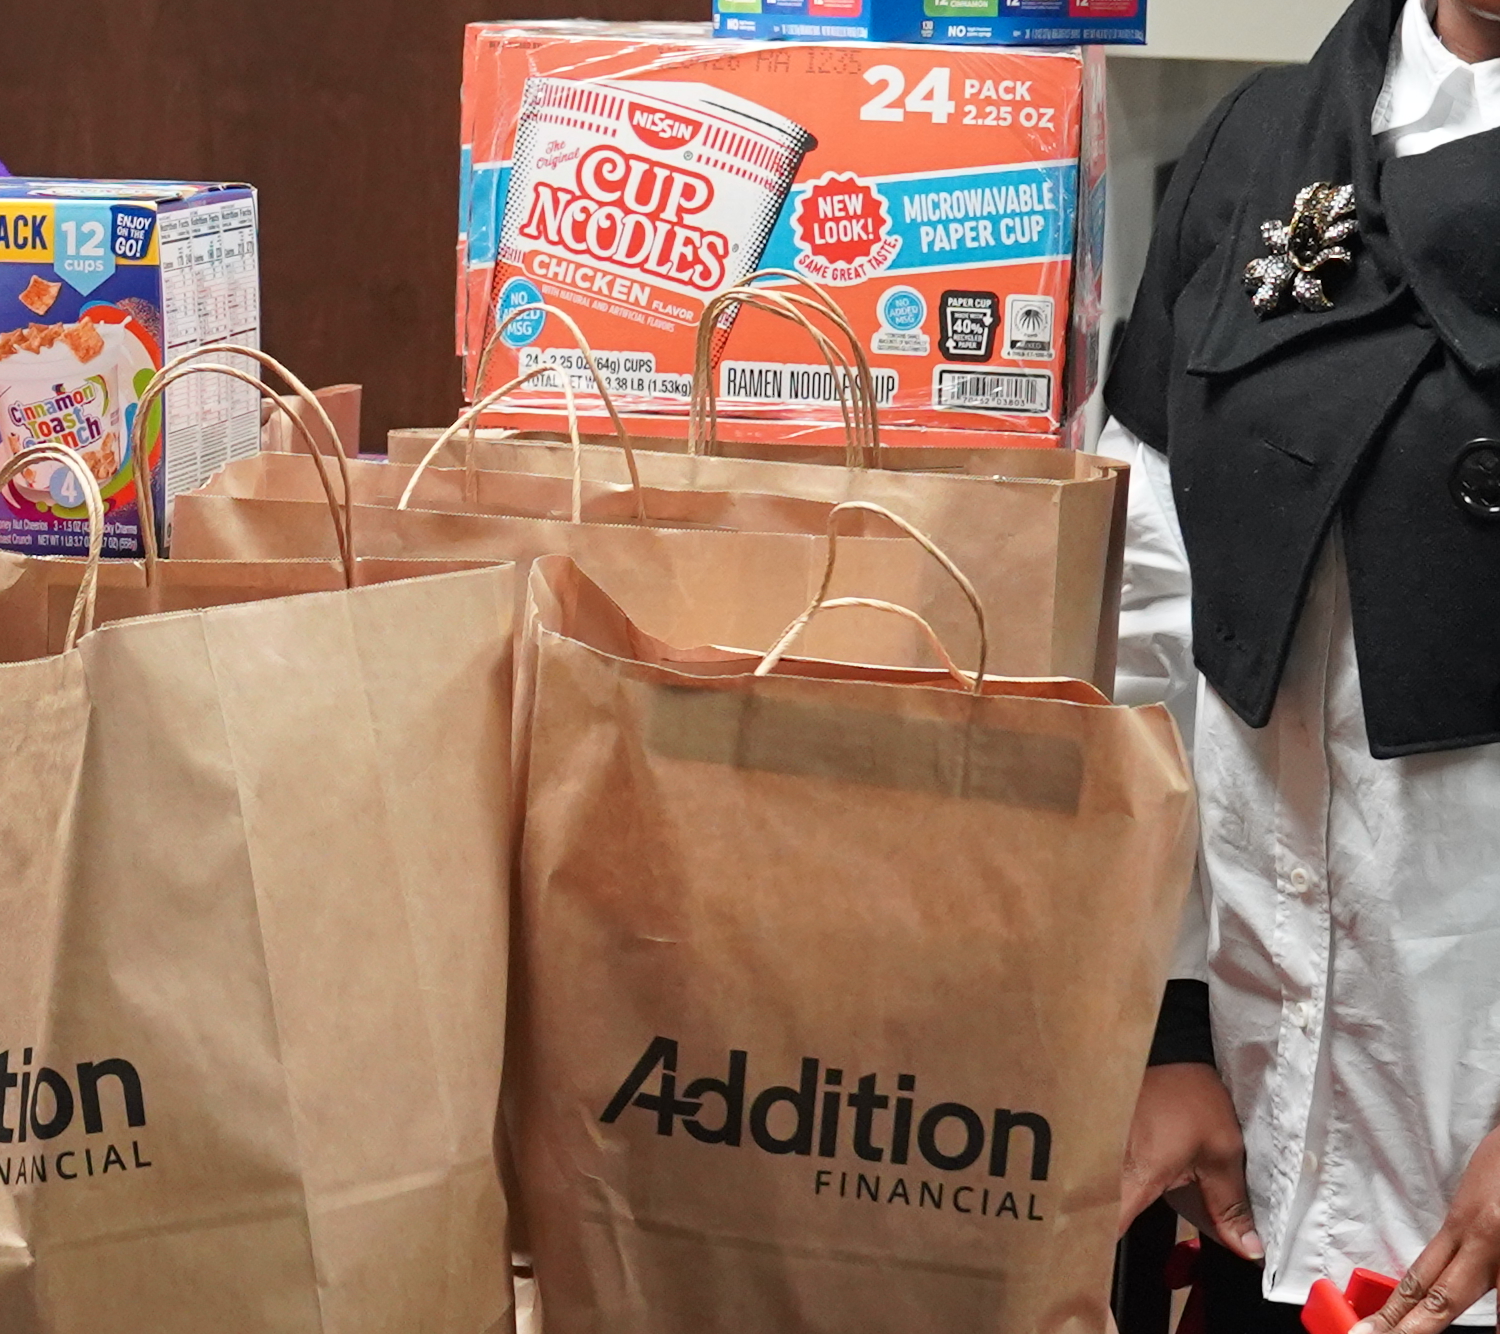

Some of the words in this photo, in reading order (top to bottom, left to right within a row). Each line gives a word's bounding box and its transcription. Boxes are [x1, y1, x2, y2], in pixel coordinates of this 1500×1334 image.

[858, 65, 956, 124] 24
[963, 78, 1032, 101] PACK
[632, 109, 694, 141] NISSIN
[961, 104, 1012, 126] 2.25
[1020, 106, 1055, 129] OZ
[577, 146, 712, 221] CUP
[817, 193, 863, 219] NEW
[903, 183, 1056, 224] MICROWAVABLE
[116, 213, 152, 231] ENJOY
[129, 228, 145, 240] THE
[813, 218, 875, 245] LOOK!
[919, 221, 995, 254] PAPER
[1000, 215, 1045, 246] CUP
[60, 220, 105, 257] 12
[115, 238, 142, 258] GO!
[520, 182, 729, 292] NOODLES
[64, 258, 104, 274] cups
[798, 253, 828, 280] SAME
[831, 264, 868, 282] GREAT
[510, 291, 528, 306] NO
[532, 254, 651, 307] CHICKEN
[651, 300, 694, 320] FLAVOR
[948, 297, 973, 307] PAPER
[975, 298, 992, 308] CUP
[953, 319, 983, 335] 40%
[624, 358, 653, 373] CUPS
[727, 367, 782, 399] RAMEN
[60, 471, 78, 502] 4
[600, 1036, 1054, 1182] Addition
[812, 1168, 1046, 1223] FINANCIAL
